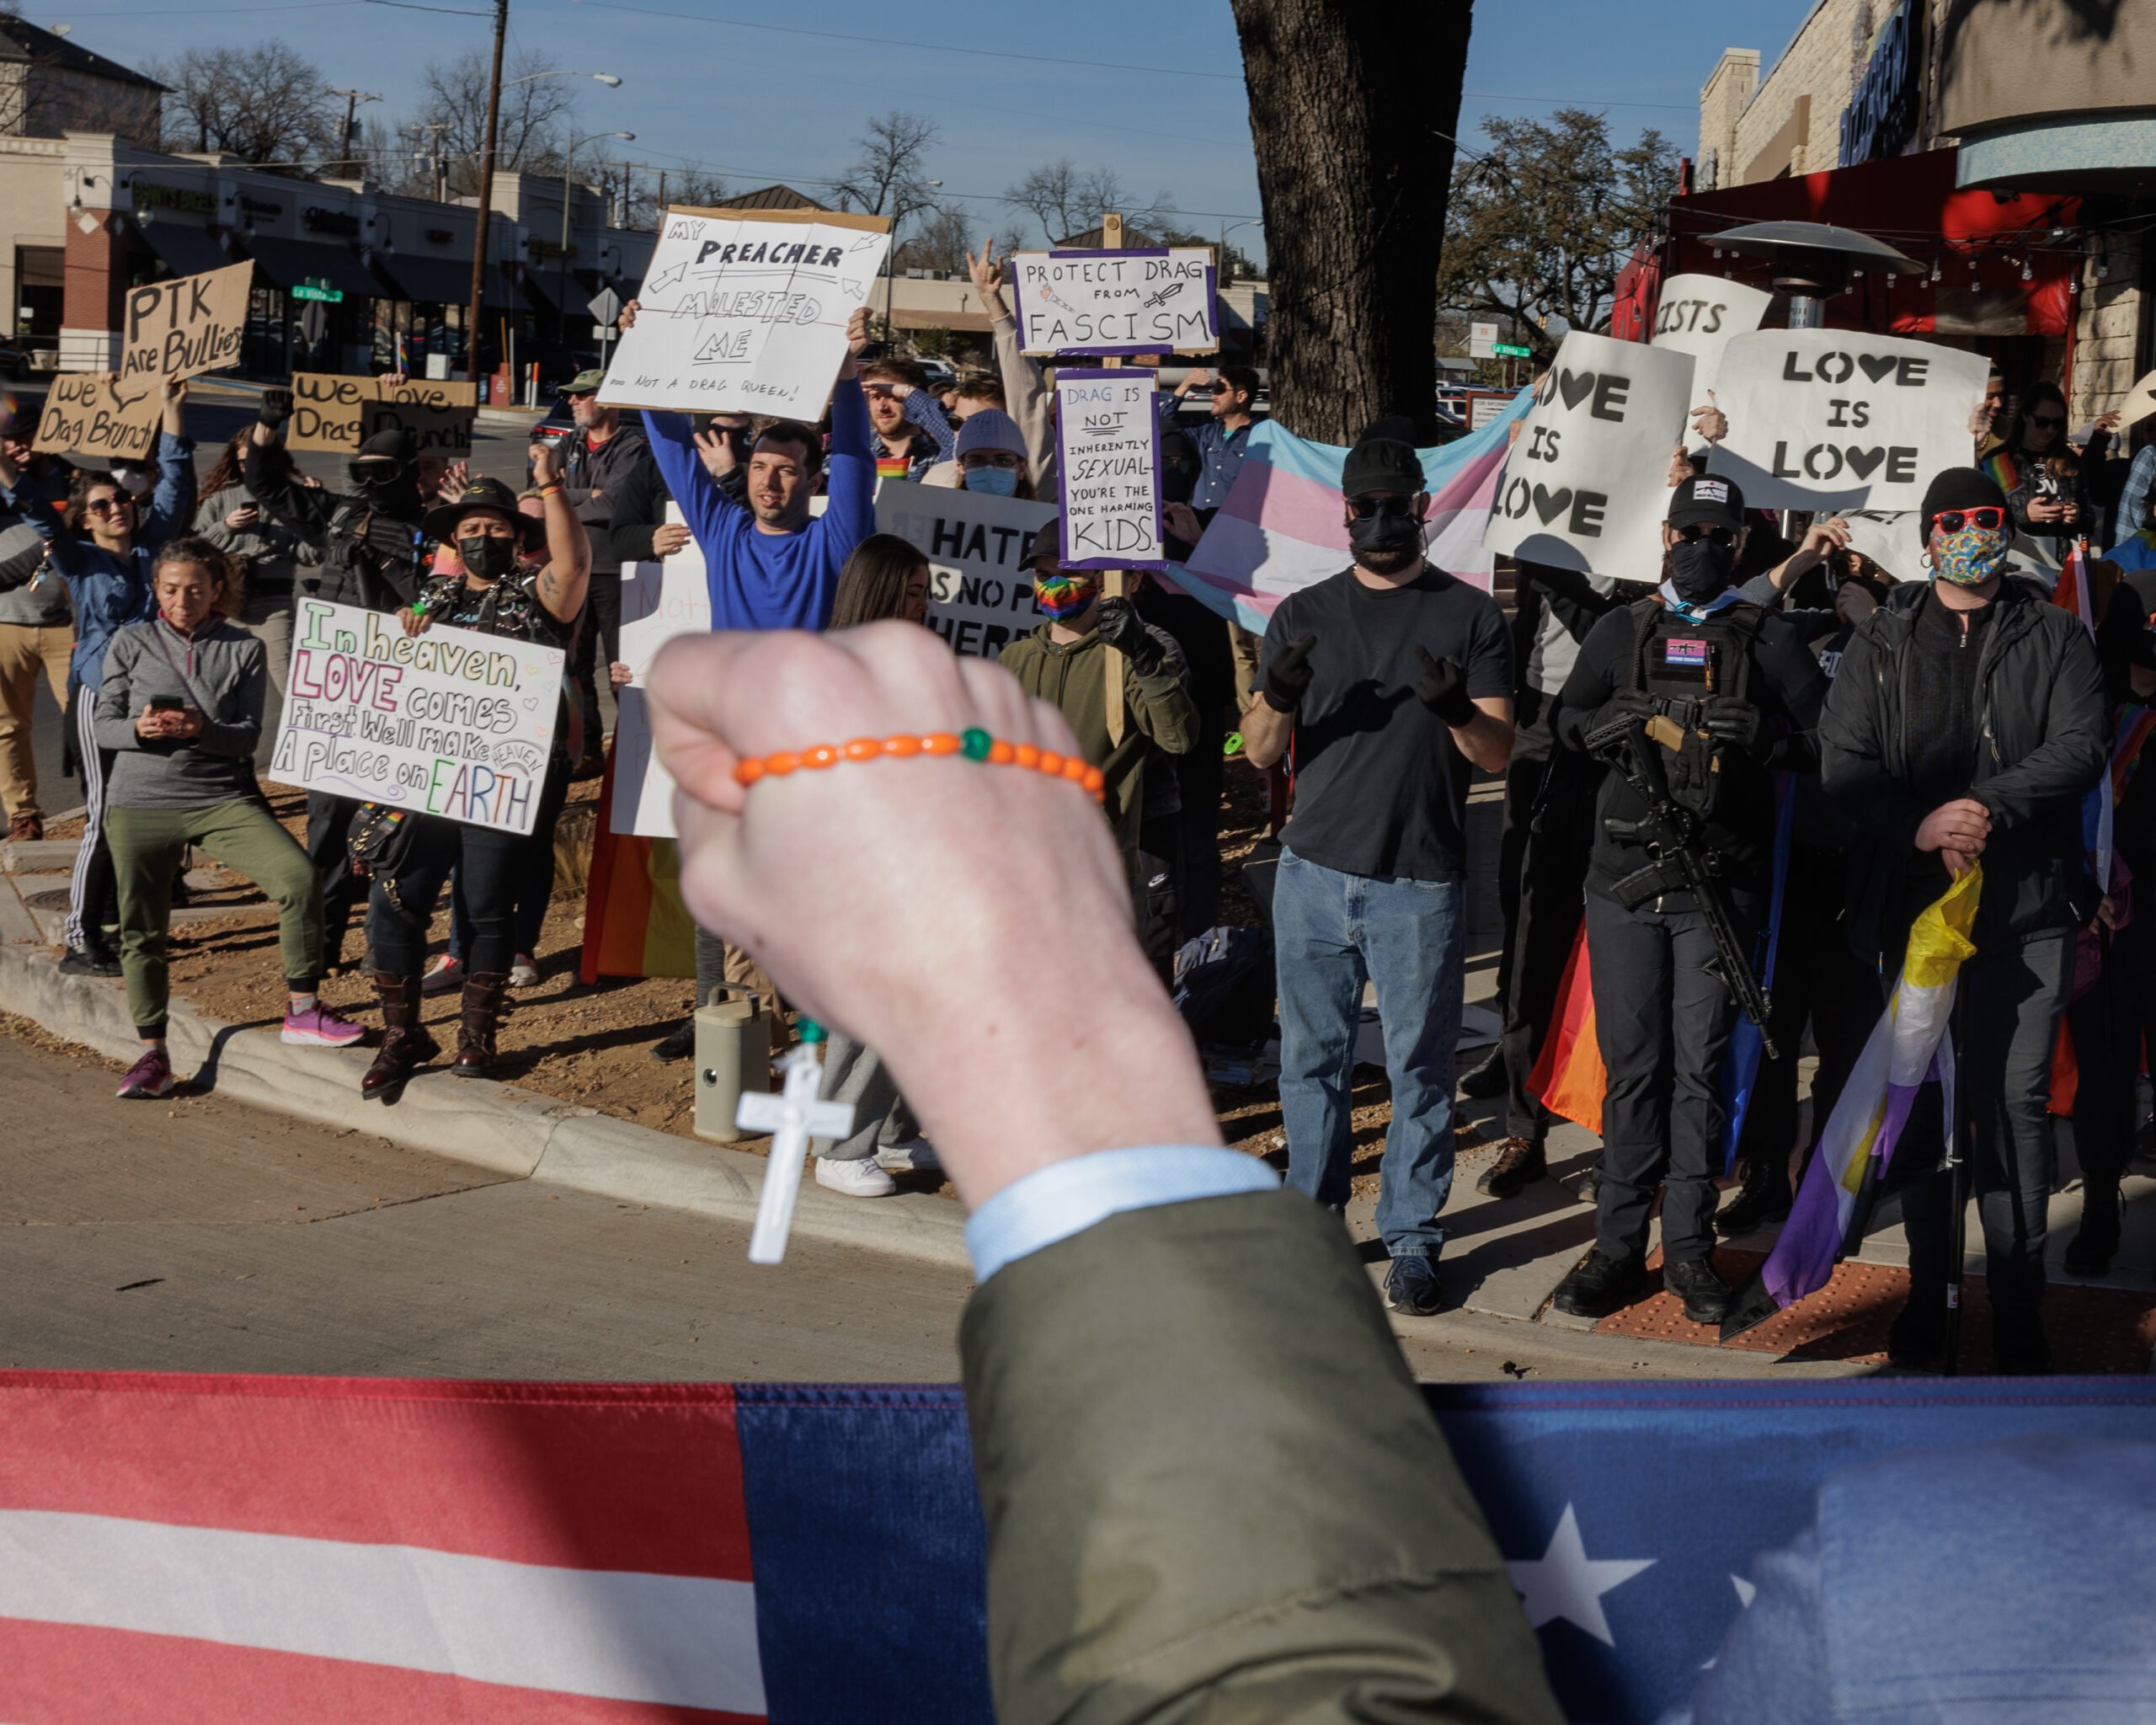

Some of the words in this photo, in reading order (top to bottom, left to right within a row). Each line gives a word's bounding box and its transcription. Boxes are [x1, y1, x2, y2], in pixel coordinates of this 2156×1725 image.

[668, 221, 707, 240] MY
[696, 240, 844, 268] PREACHER
[1027, 260, 1128, 283] PROTECT
[1145, 259, 1203, 280] DRAG
[1094, 288, 1140, 300] FROM
[130, 278, 212, 344] PTK
[1030, 310, 1209, 344] FASCISM
[694, 329, 752, 360] ME
[124, 347, 157, 379] Are
[296, 376, 363, 405] We
[634, 374, 660, 388] NOT
[667, 377, 678, 389] A
[690, 377, 728, 391] DRAG
[741, 381, 800, 402] QUEEN!
[1067, 387, 1113, 405] DRAG
[1124, 387, 1139, 403] IS
[40, 407, 83, 446] Drag
[87, 409, 152, 450] Brunch
[295, 406, 365, 449] Drag
[1085, 412, 1129, 427] NOT
[1827, 399, 1870, 429] IS
[1070, 439, 1150, 455] INHERENTLY
[1527, 425, 1561, 463] IS
[1070, 486, 1117, 502] YOU'RE
[1124, 485, 1150, 498] THE
[1070, 505, 1095, 515] ONE
[1101, 502, 1153, 514] HARMING
[1074, 515, 1155, 552] KIDS.
[957, 574, 1005, 608] NO
[301, 601, 357, 654] In
[291, 649, 404, 712] LOVE
[406, 686, 519, 734] comes
[491, 745, 543, 772] HEAVEN
[273, 729, 298, 772] A
[302, 735, 391, 783] place
[396, 762, 430, 791] on
[426, 758, 534, 830] EARTH
